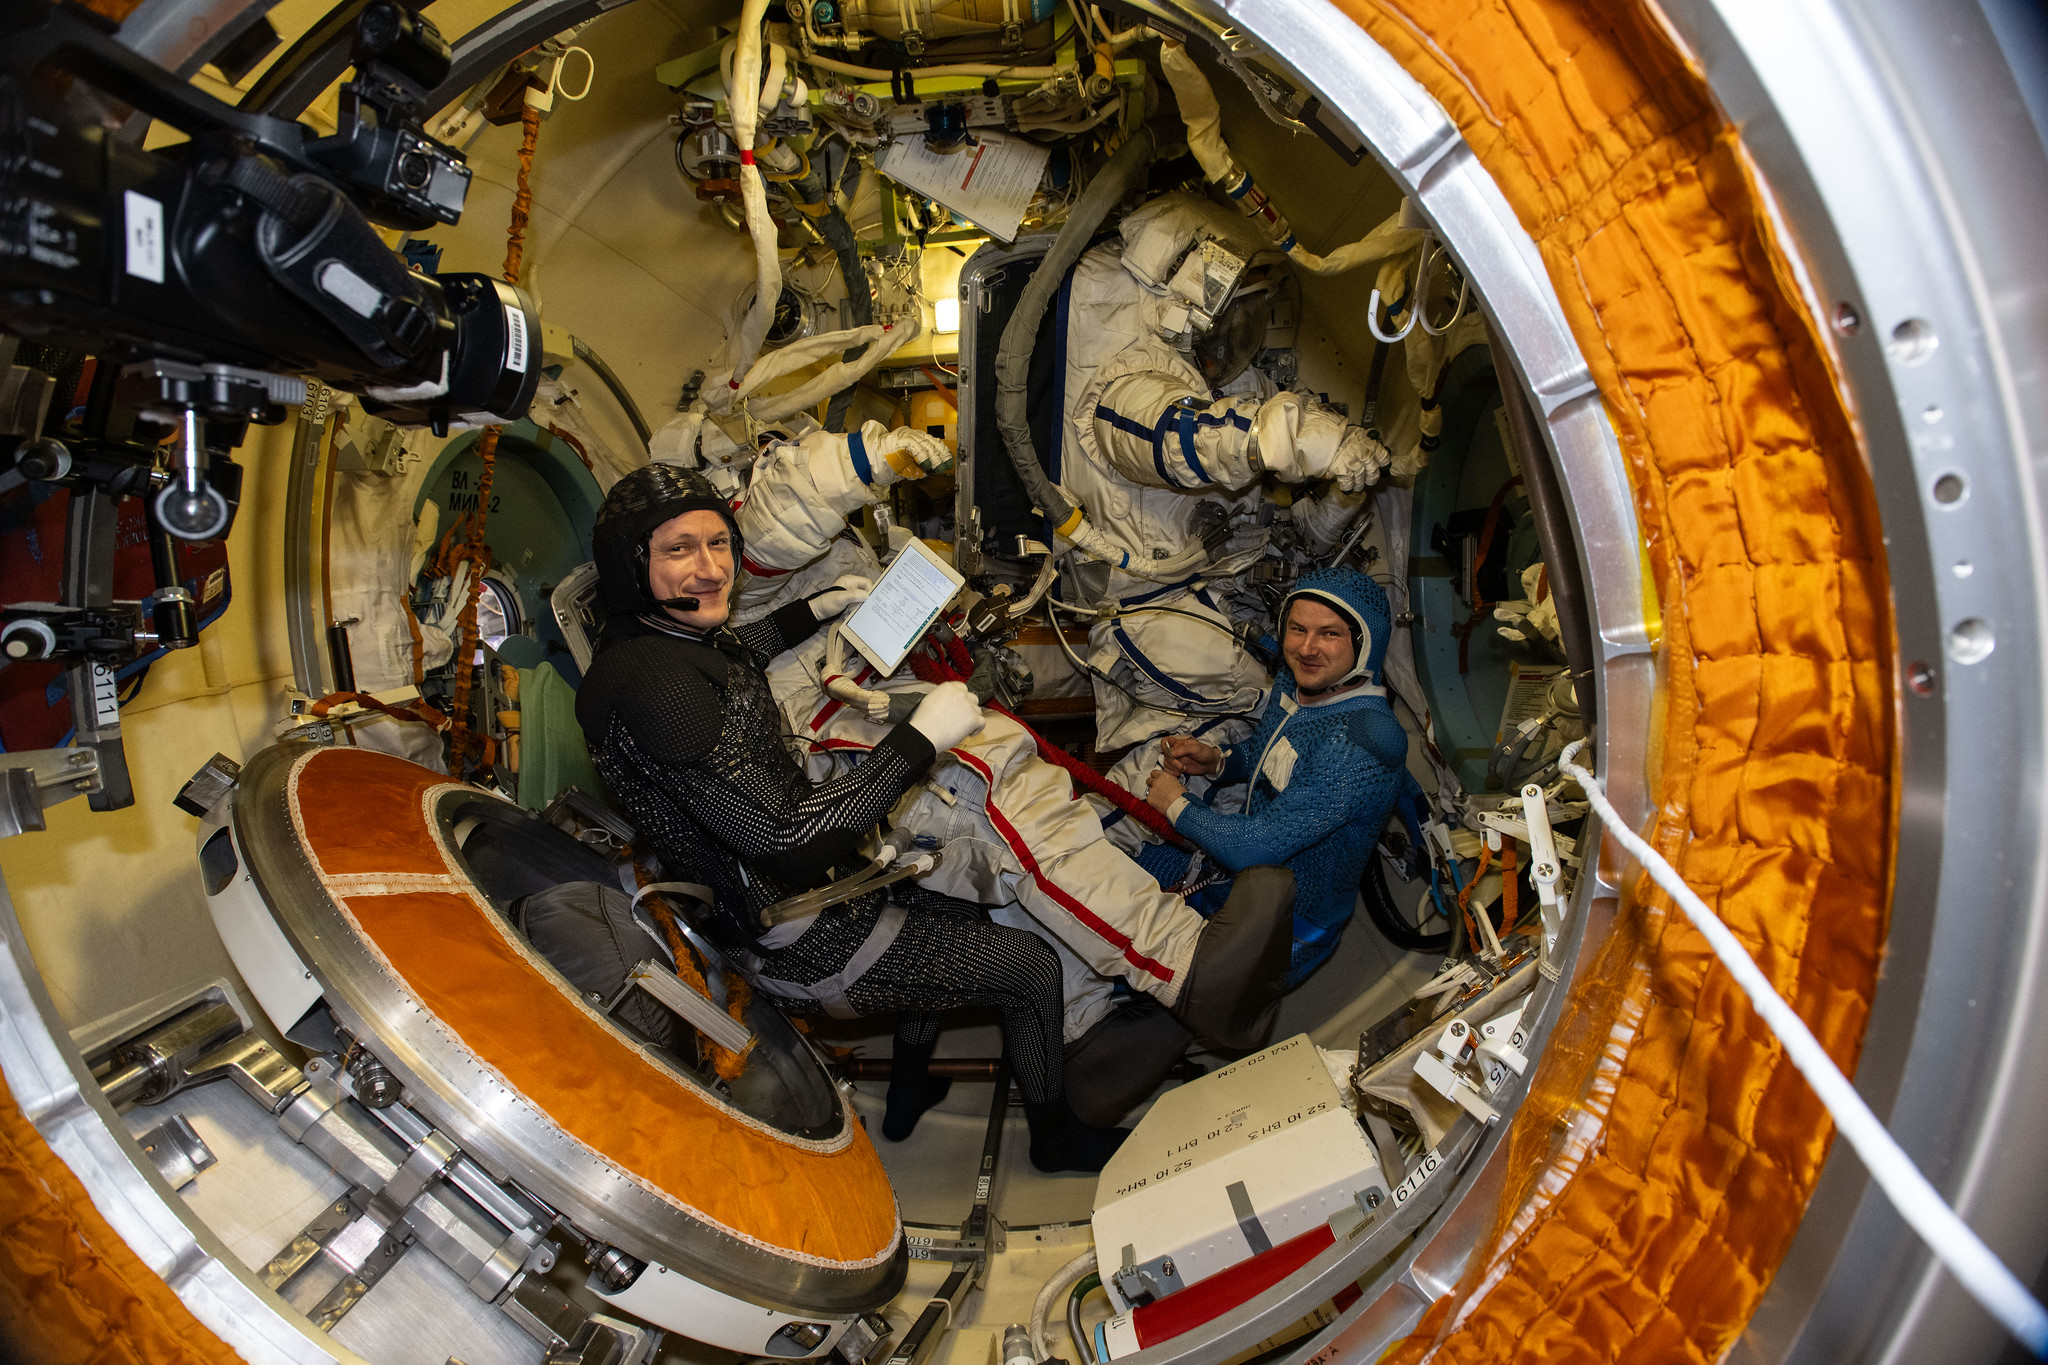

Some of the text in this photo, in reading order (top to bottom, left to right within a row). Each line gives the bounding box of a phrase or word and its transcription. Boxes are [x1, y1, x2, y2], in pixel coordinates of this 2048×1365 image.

[302, 382, 318, 416] 6103
[315, 388, 331, 420] 6103
[94, 664, 116, 714] 6111
[977, 1177, 989, 1198] 6118
[1395, 1155, 1439, 1204] 6116
